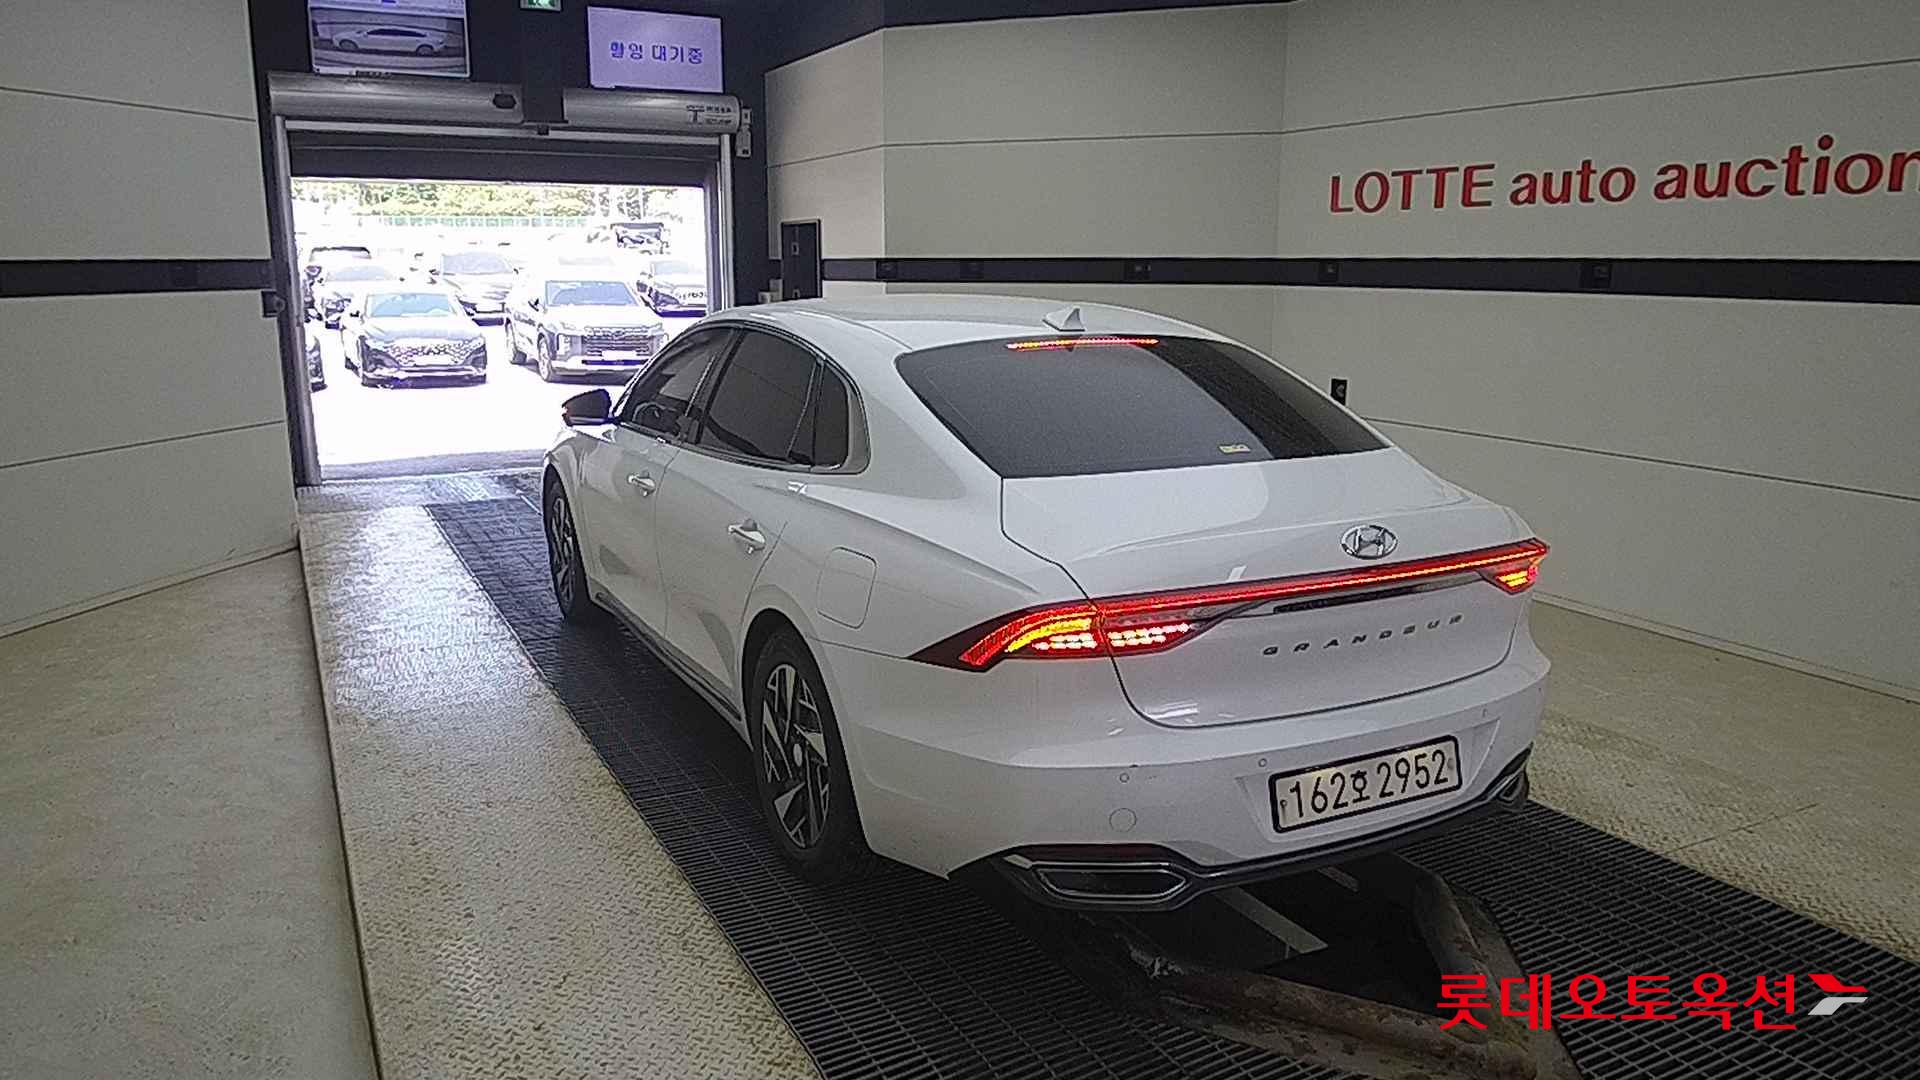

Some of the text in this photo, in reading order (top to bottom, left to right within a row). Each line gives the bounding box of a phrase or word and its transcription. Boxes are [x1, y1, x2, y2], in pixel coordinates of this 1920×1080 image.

[651, 44, 703, 65] 대기중
[1330, 134, 1920, 214] LOTTE auto auction
[1263, 614, 1463, 656] GRANDEUR
